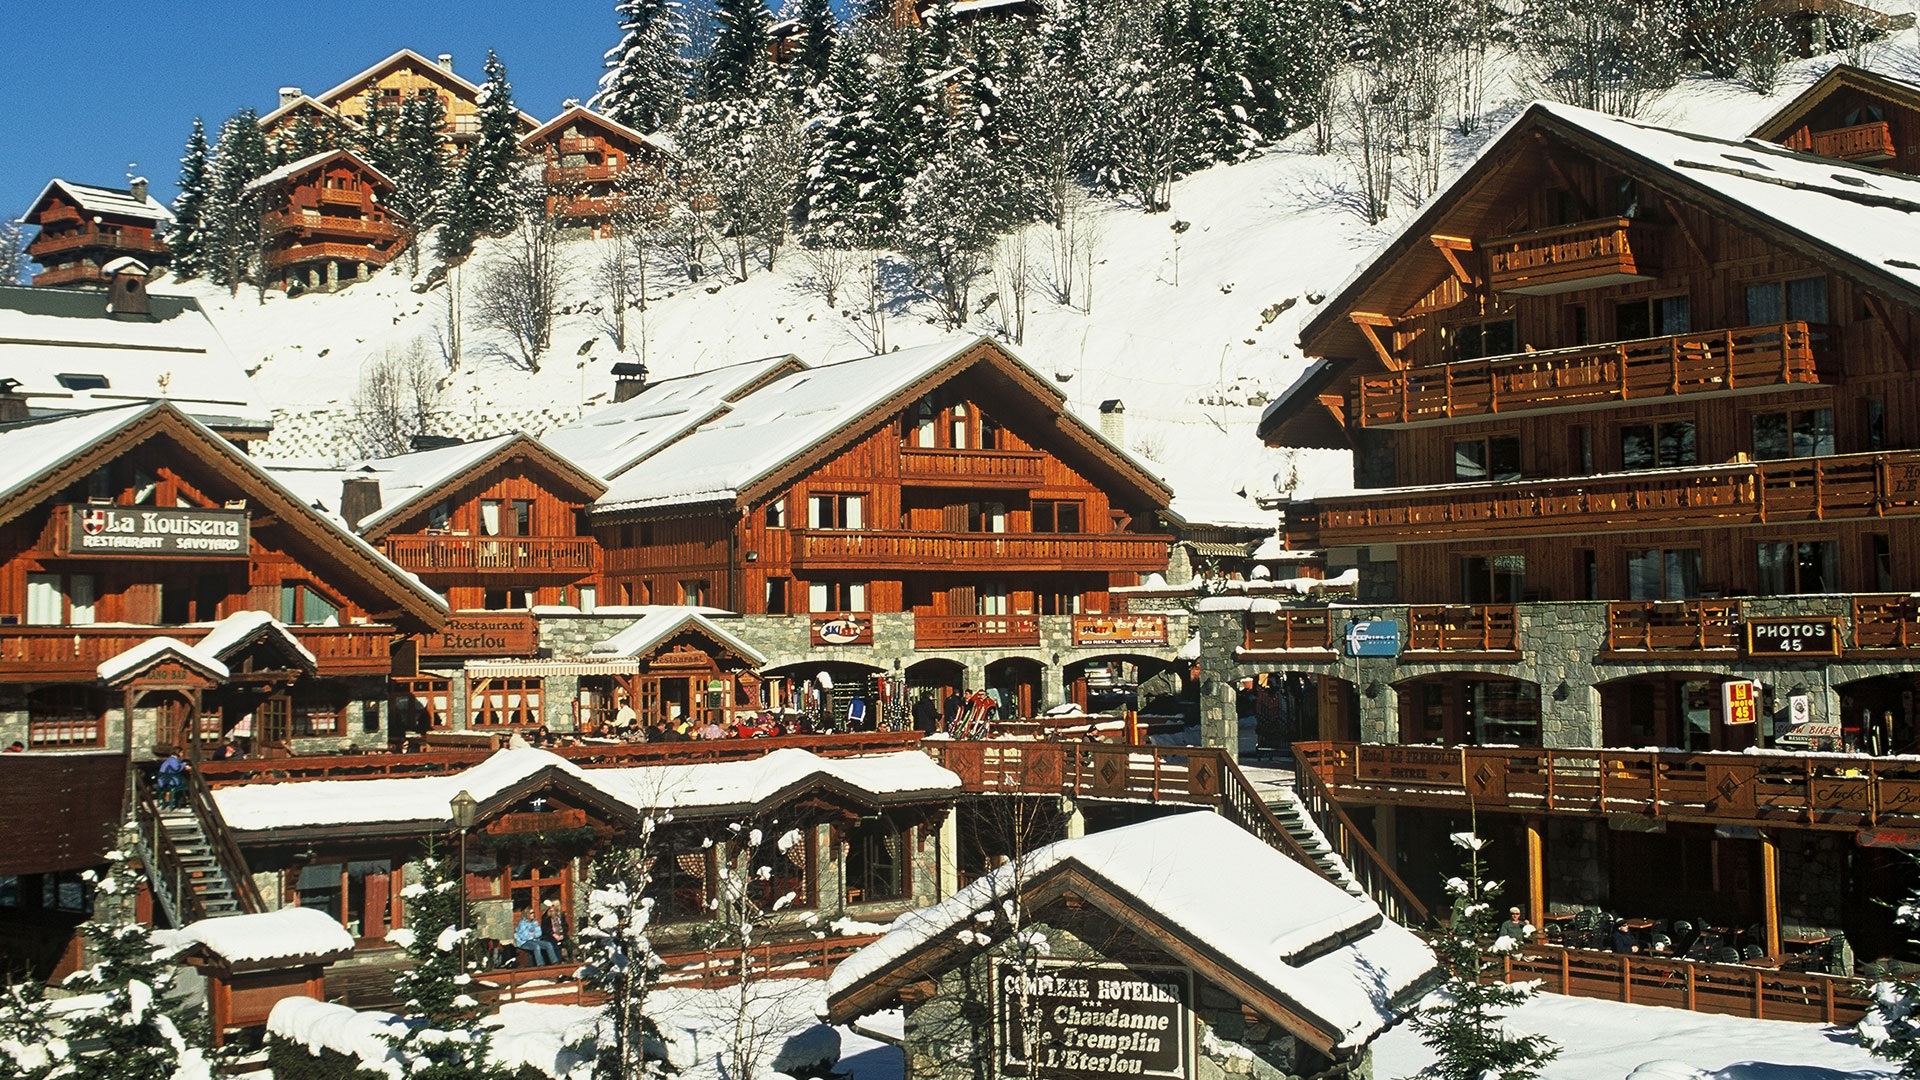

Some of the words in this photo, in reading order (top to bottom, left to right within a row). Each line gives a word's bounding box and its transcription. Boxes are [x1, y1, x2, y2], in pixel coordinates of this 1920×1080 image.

[105, 511, 135, 533] La
[83, 535, 164, 549] RESTAURANT
[176, 537, 239, 550] SAVOYARD
[450, 620, 525, 630] Restaurant
[1756, 624, 1826, 638] PHOTOS
[443, 633, 506, 648] Eterlou
[1780, 639, 1802, 651] 45
[1730, 699, 1754, 708] PHOTO
[1735, 706, 1750, 718] 45
[1808, 725, 1839, 736] BIKER
[1098, 980, 1181, 1003] HOTELIER
[1053, 1004, 1169, 1031] Chaudanne
[1063, 1027, 1161, 1054] Tremplin
[1045, 1048, 1143, 1075] L'Eterlou
